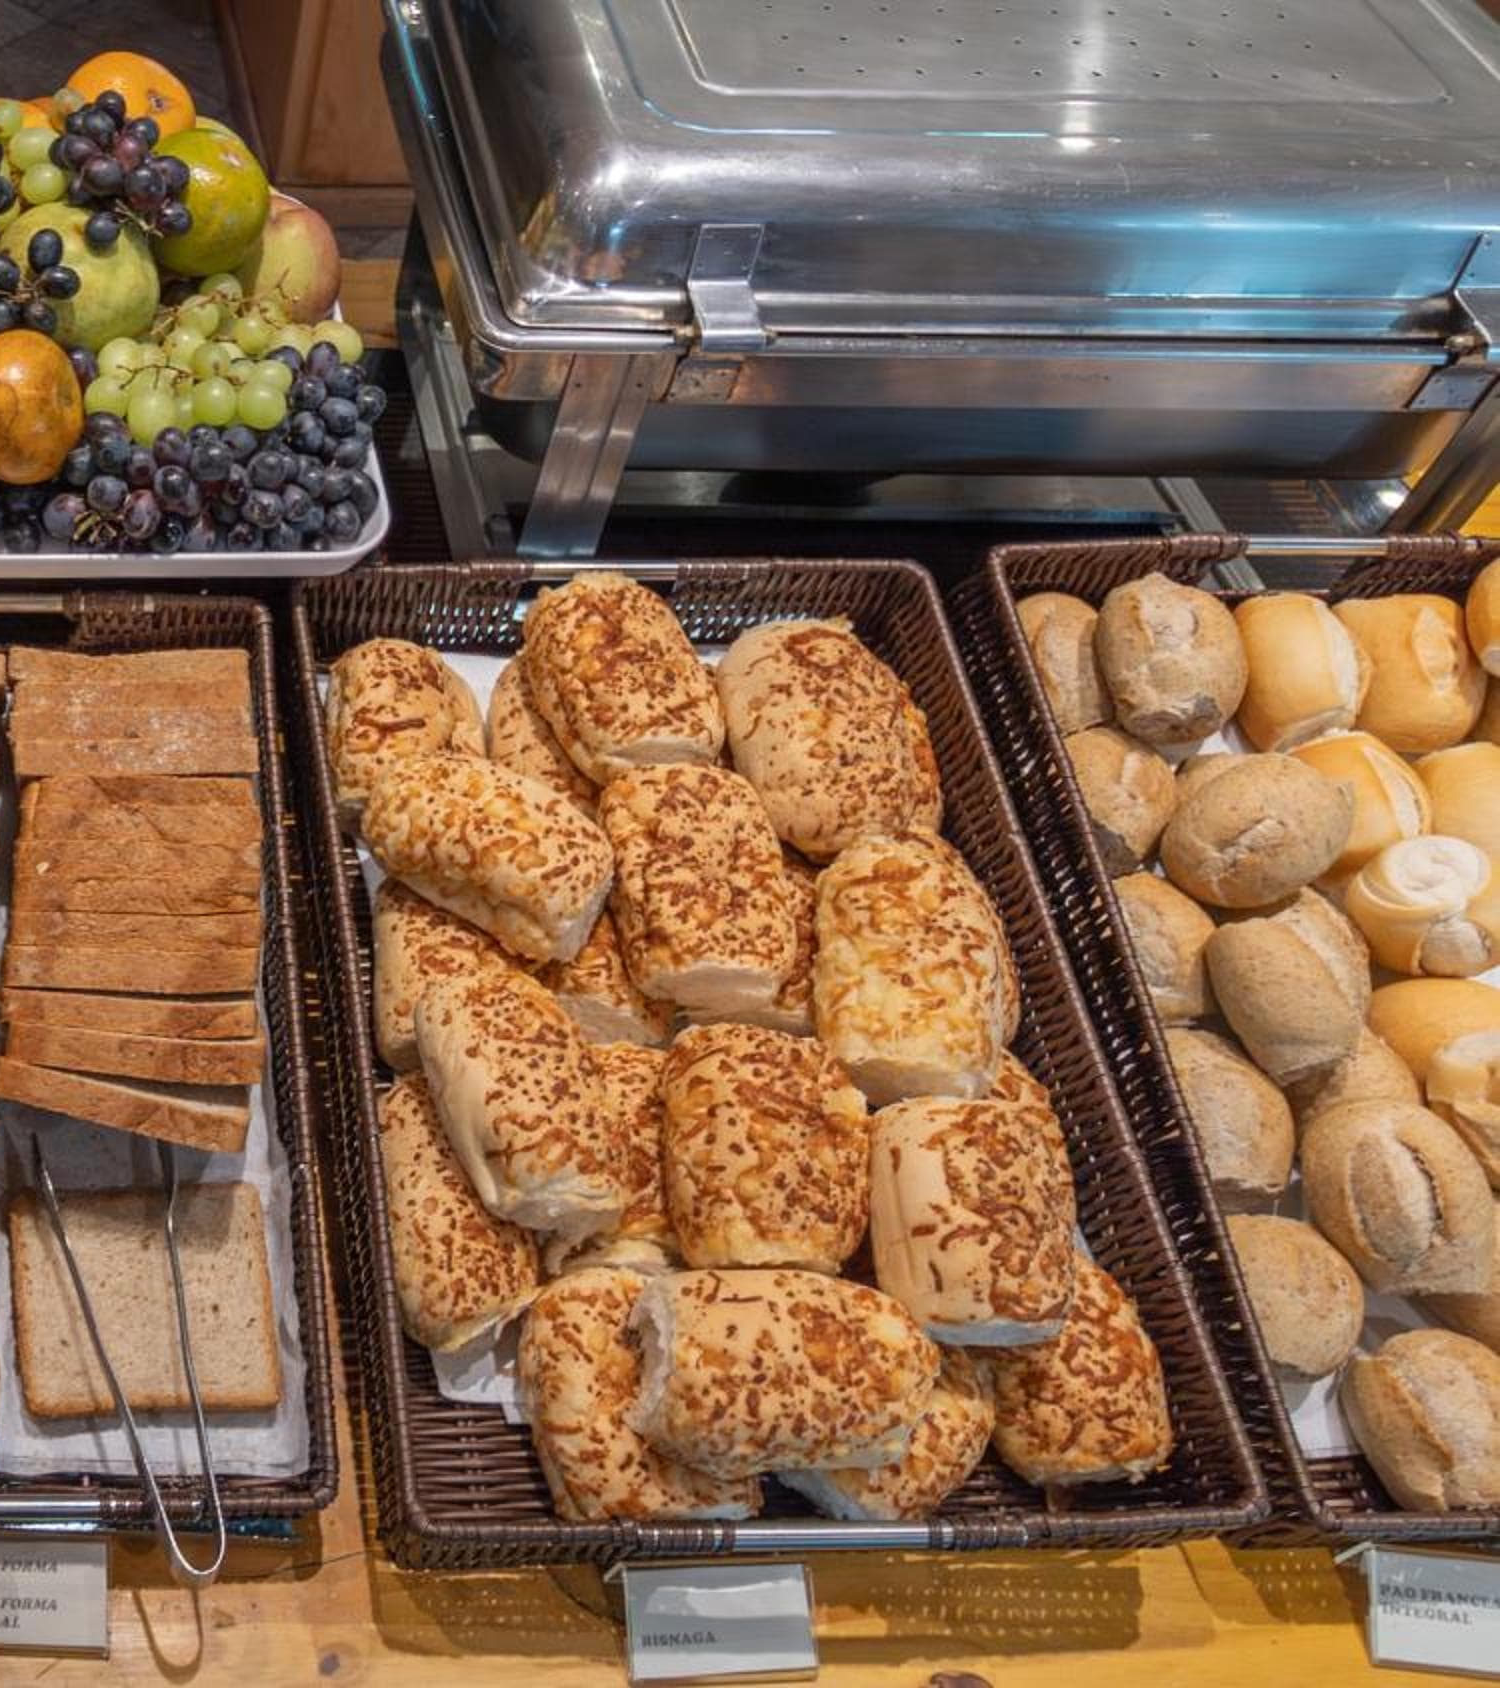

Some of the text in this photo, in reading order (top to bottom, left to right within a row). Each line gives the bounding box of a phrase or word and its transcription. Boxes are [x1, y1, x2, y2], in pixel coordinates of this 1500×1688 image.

[0, 1559, 58, 1573] FORMA
[1379, 1600, 1473, 1625] INTEGRAL
[641, 1631, 718, 1648] BISNAGA
